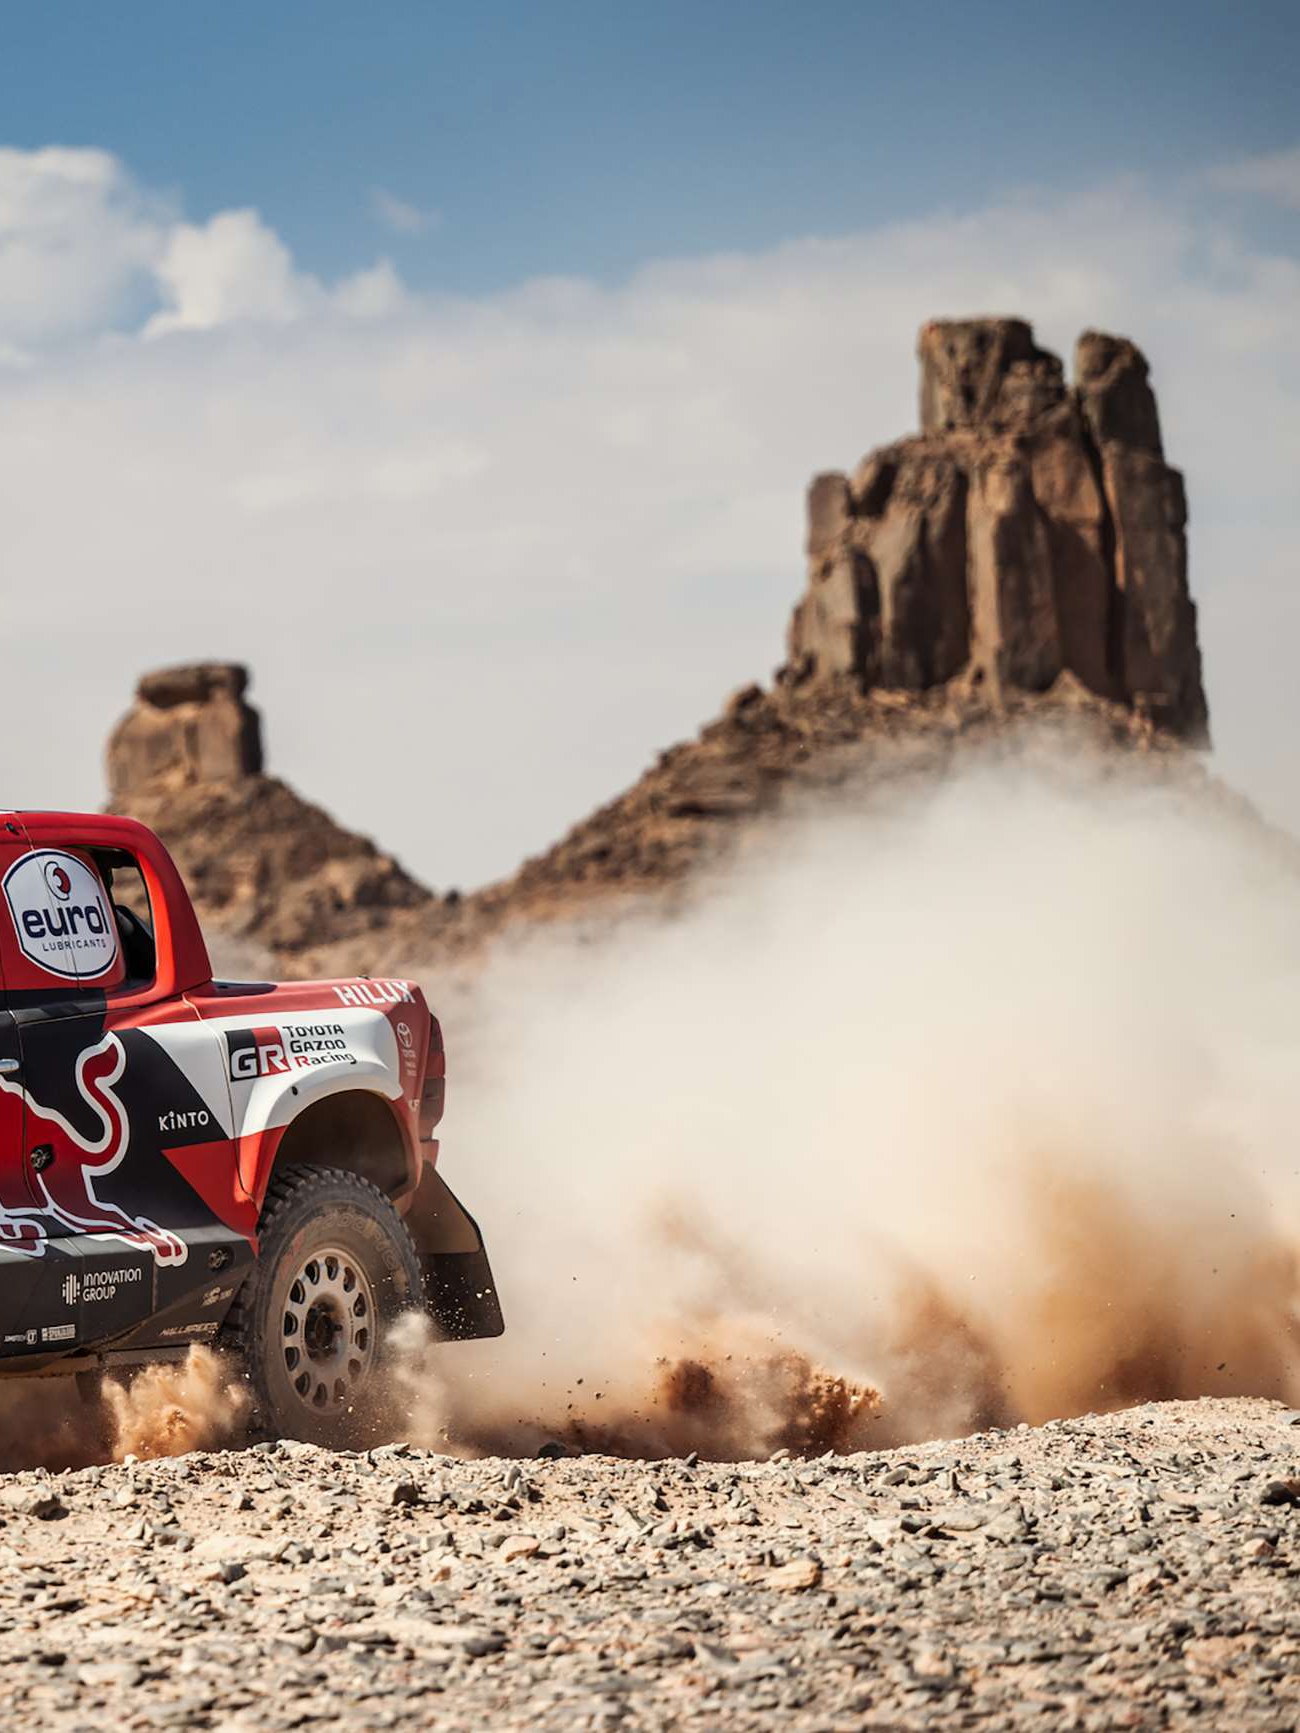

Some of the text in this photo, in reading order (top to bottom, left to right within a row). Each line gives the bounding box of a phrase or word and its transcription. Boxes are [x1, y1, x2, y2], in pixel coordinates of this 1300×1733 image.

[21, 895, 110, 939] eurol
[42, 938, 108, 953] LUBRICANTS
[332, 981, 416, 1006] HILUX
[282, 1024, 345, 1038] TOYOTA
[290, 1038, 346, 1053] GAZOO
[231, 1043, 291, 1079] GR
[295, 1050, 358, 1067] Racing
[83, 1267, 142, 1286] INNOVATION
[83, 1286, 116, 1302] GROUP
